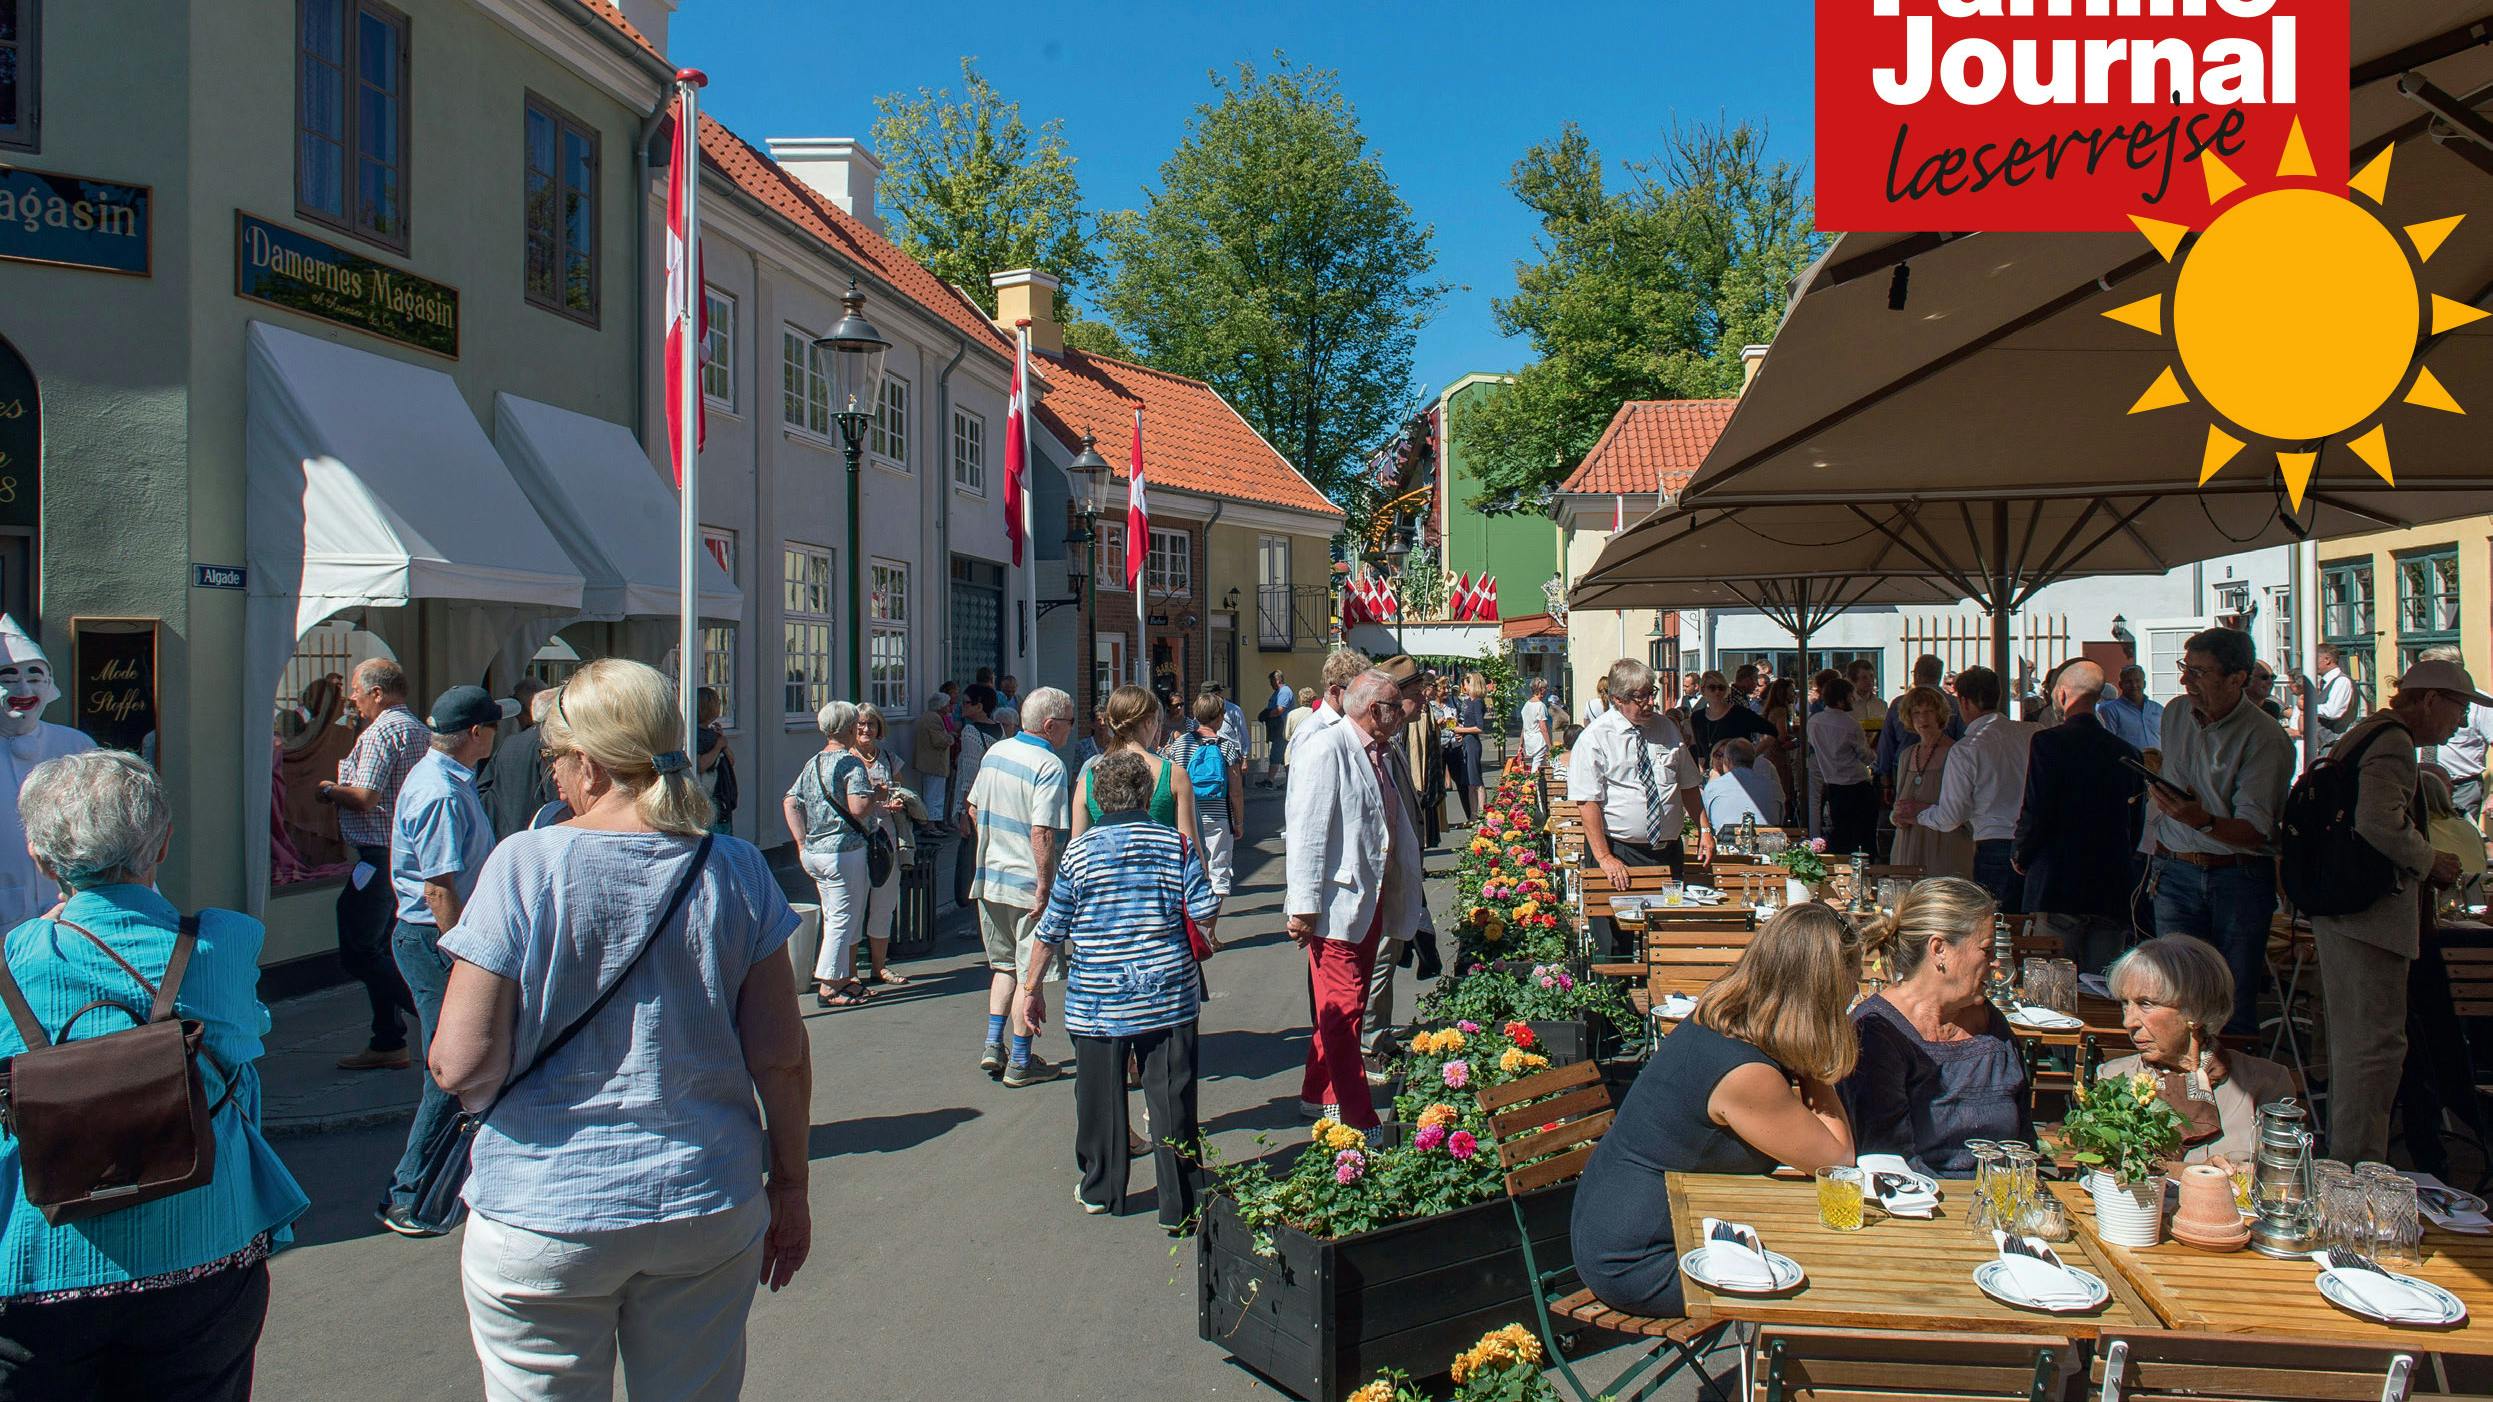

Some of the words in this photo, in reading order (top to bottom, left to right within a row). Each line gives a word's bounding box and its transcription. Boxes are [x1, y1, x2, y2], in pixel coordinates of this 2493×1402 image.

[245, 225, 363, 299] Damernes
[370, 269, 454, 329] Magasin
[204, 568, 240, 586] Algade
[91, 659, 138, 681] Mode
[88, 688, 145, 721] Stoffer
